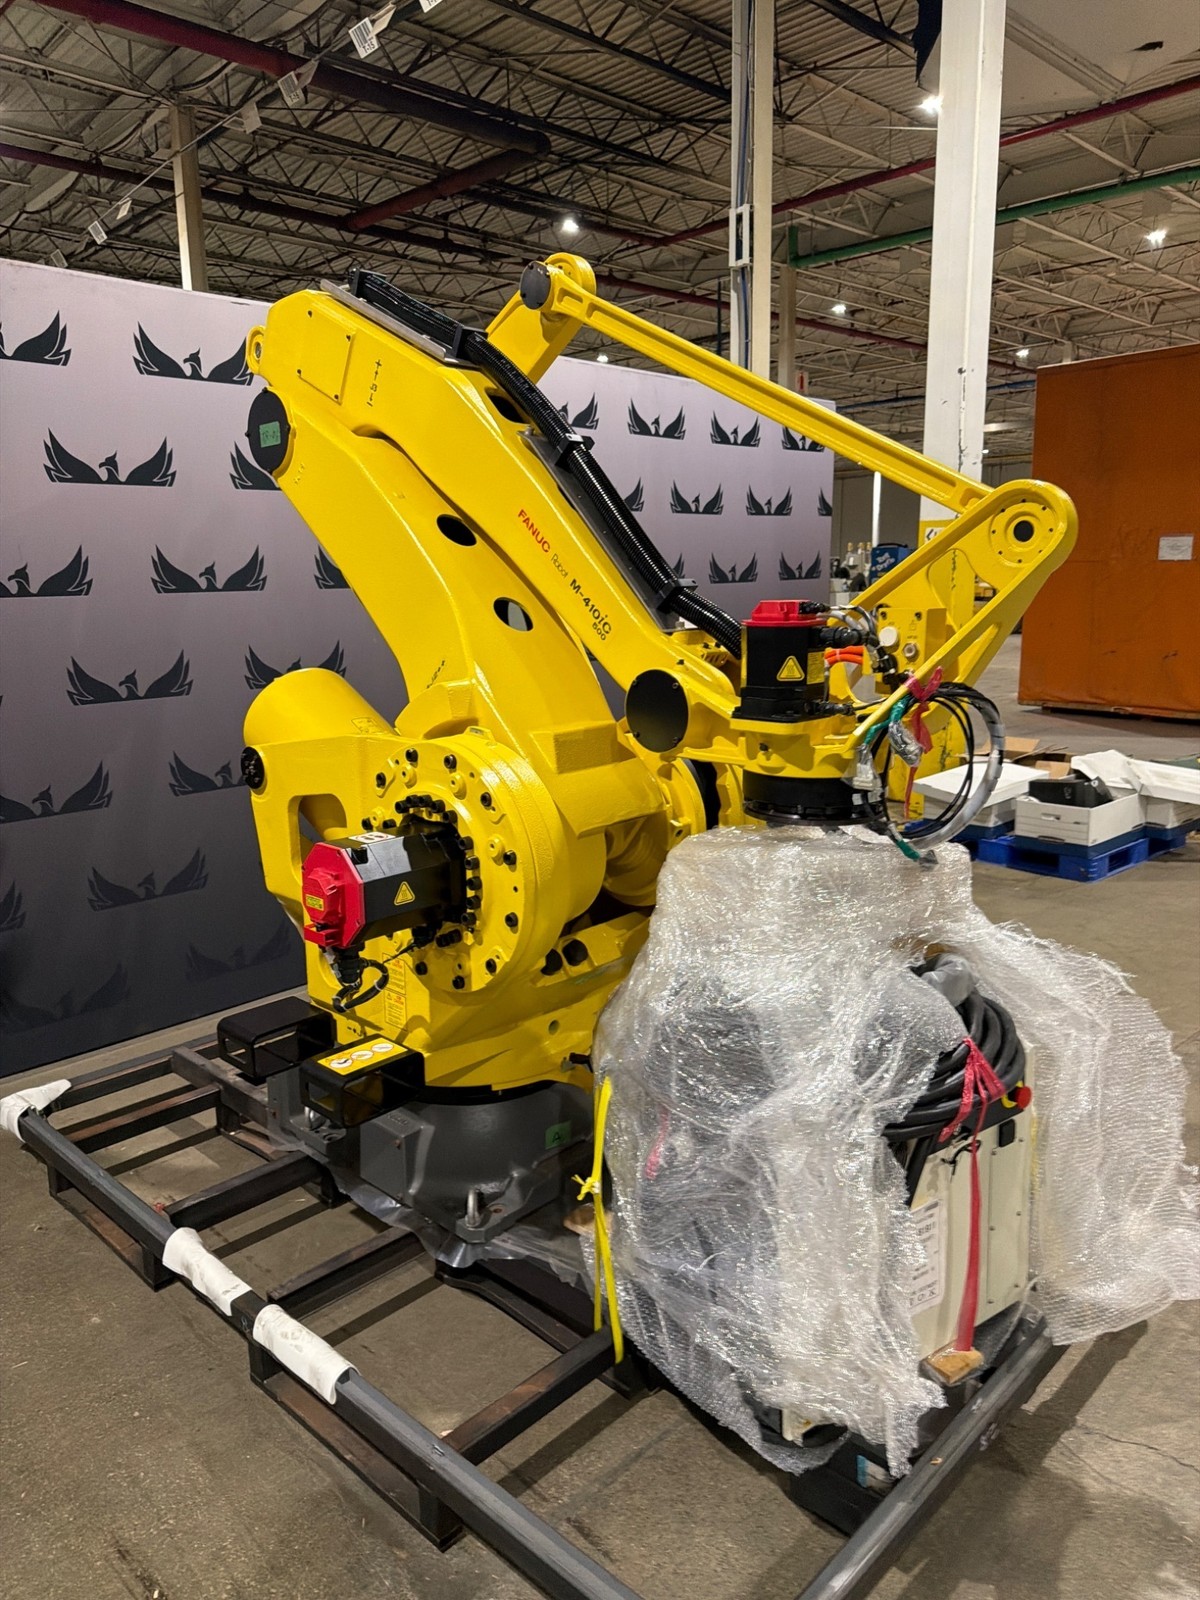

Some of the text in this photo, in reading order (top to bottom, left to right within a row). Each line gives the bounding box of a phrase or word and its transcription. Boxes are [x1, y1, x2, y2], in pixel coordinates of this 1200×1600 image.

[362, 41, 376, 54] T-15
[518, 509, 612, 635] FANUC Robot M-410iC
